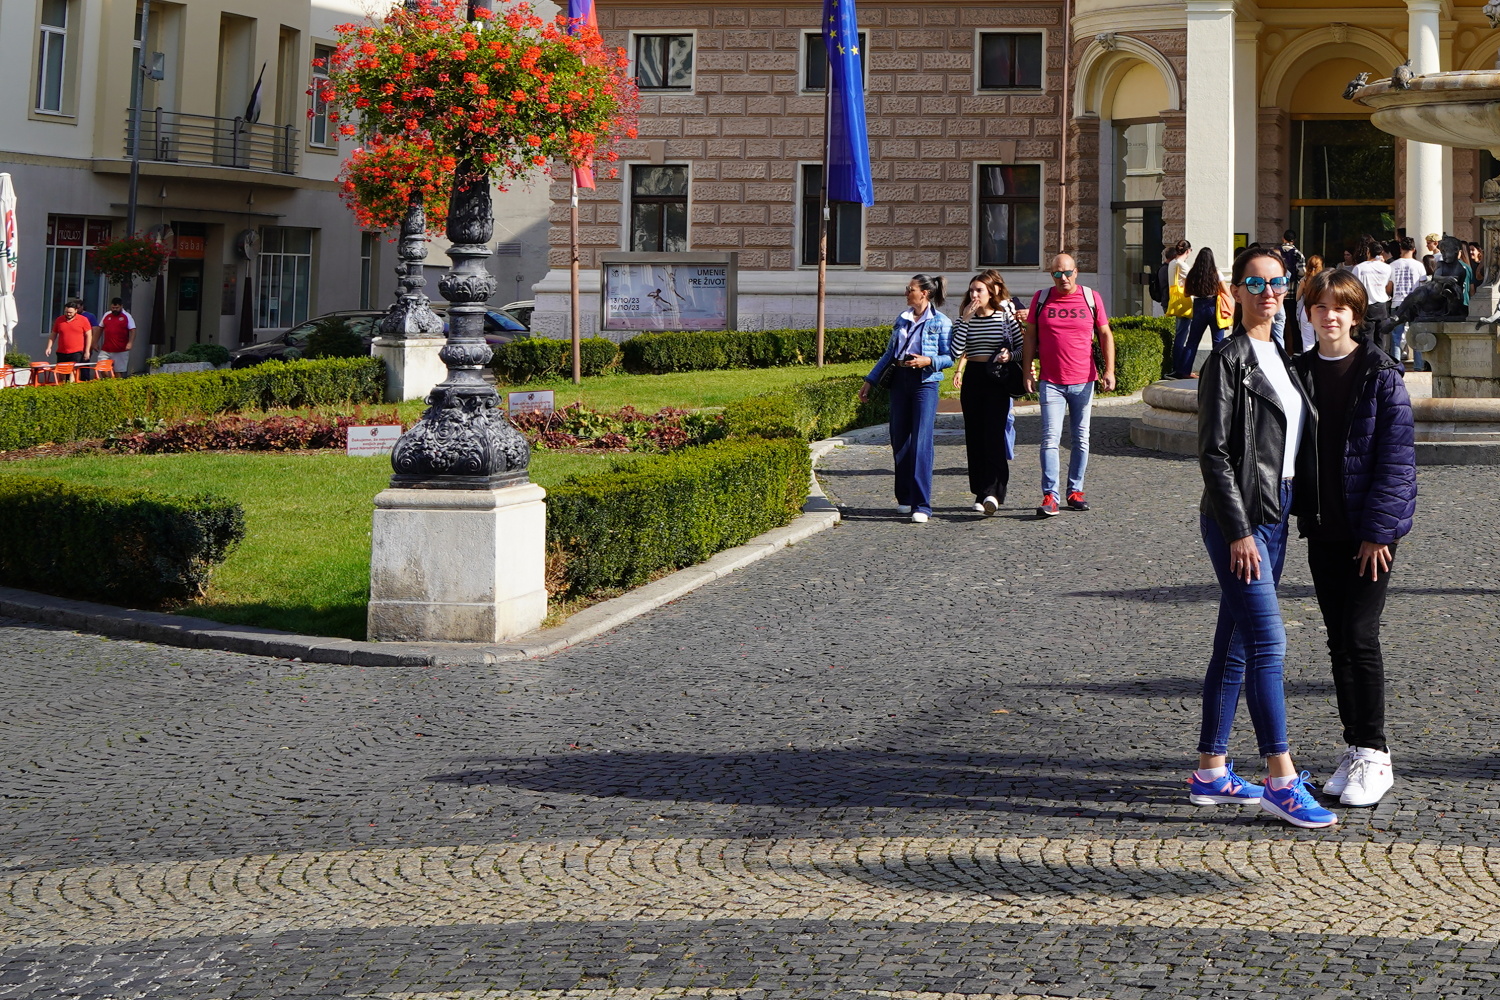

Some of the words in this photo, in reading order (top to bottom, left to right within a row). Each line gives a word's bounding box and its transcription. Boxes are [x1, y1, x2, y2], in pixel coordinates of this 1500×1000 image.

[688, 278, 702, 286] PRE
[703, 276, 726, 286] ŽIVOT
[1047, 308, 1087, 319] BOSS
